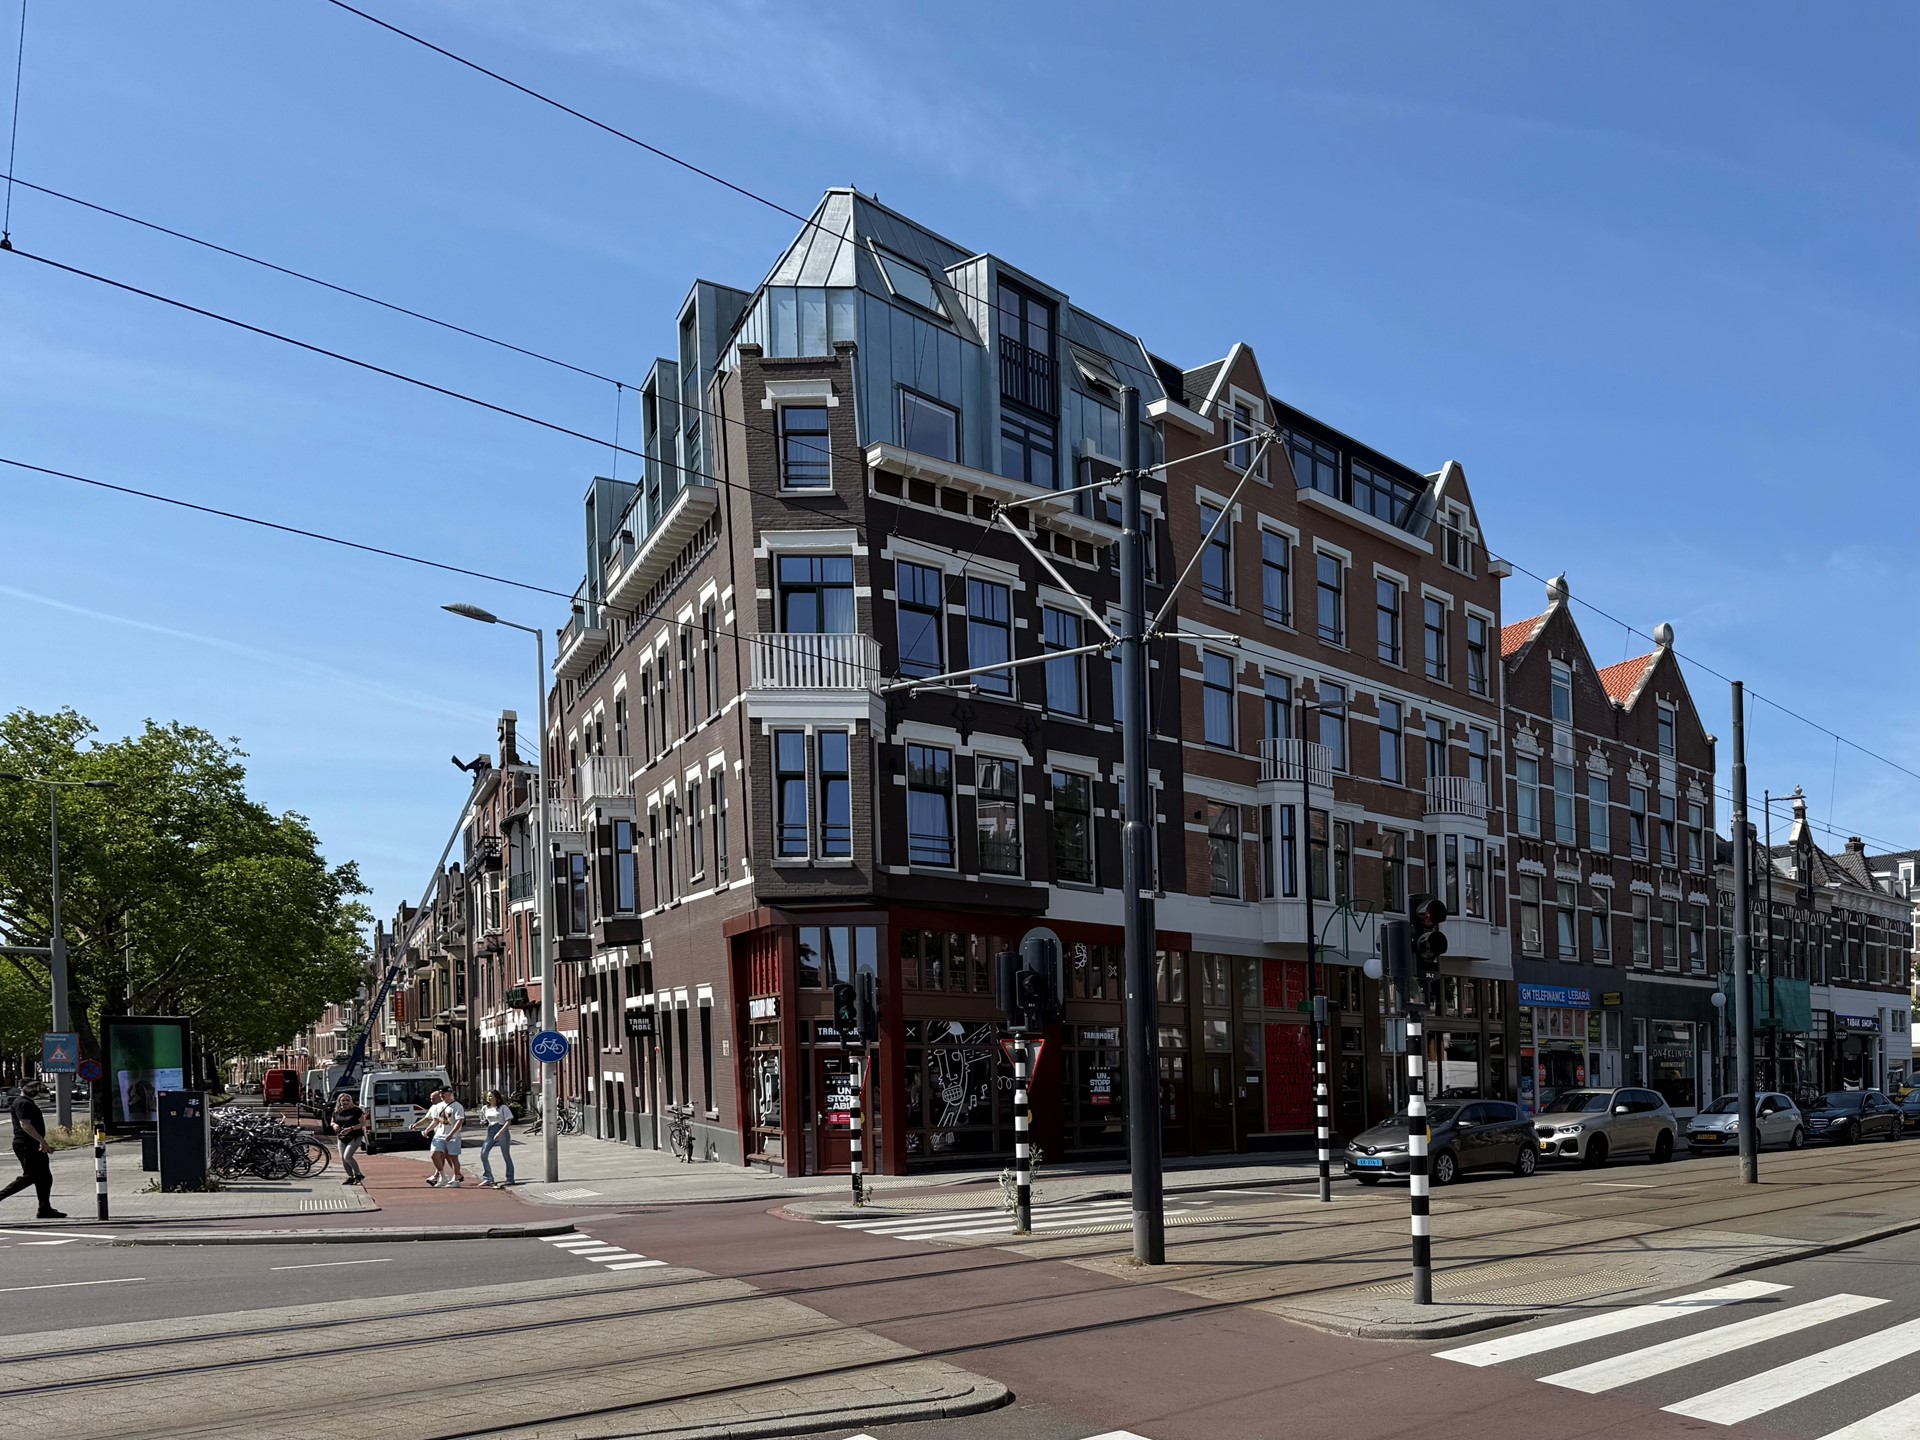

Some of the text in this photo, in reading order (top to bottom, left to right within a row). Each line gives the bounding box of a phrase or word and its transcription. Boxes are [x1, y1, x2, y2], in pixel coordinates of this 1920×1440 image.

[1521, 988, 1531, 1000] GM
[1531, 989, 1565, 1002] TELEFINANCE
[1567, 990, 1590, 1001] LEBARA
[1846, 1018, 1873, 1028] TABAK SHOP
[1083, 1031, 1115, 1040] TRAINMORE
